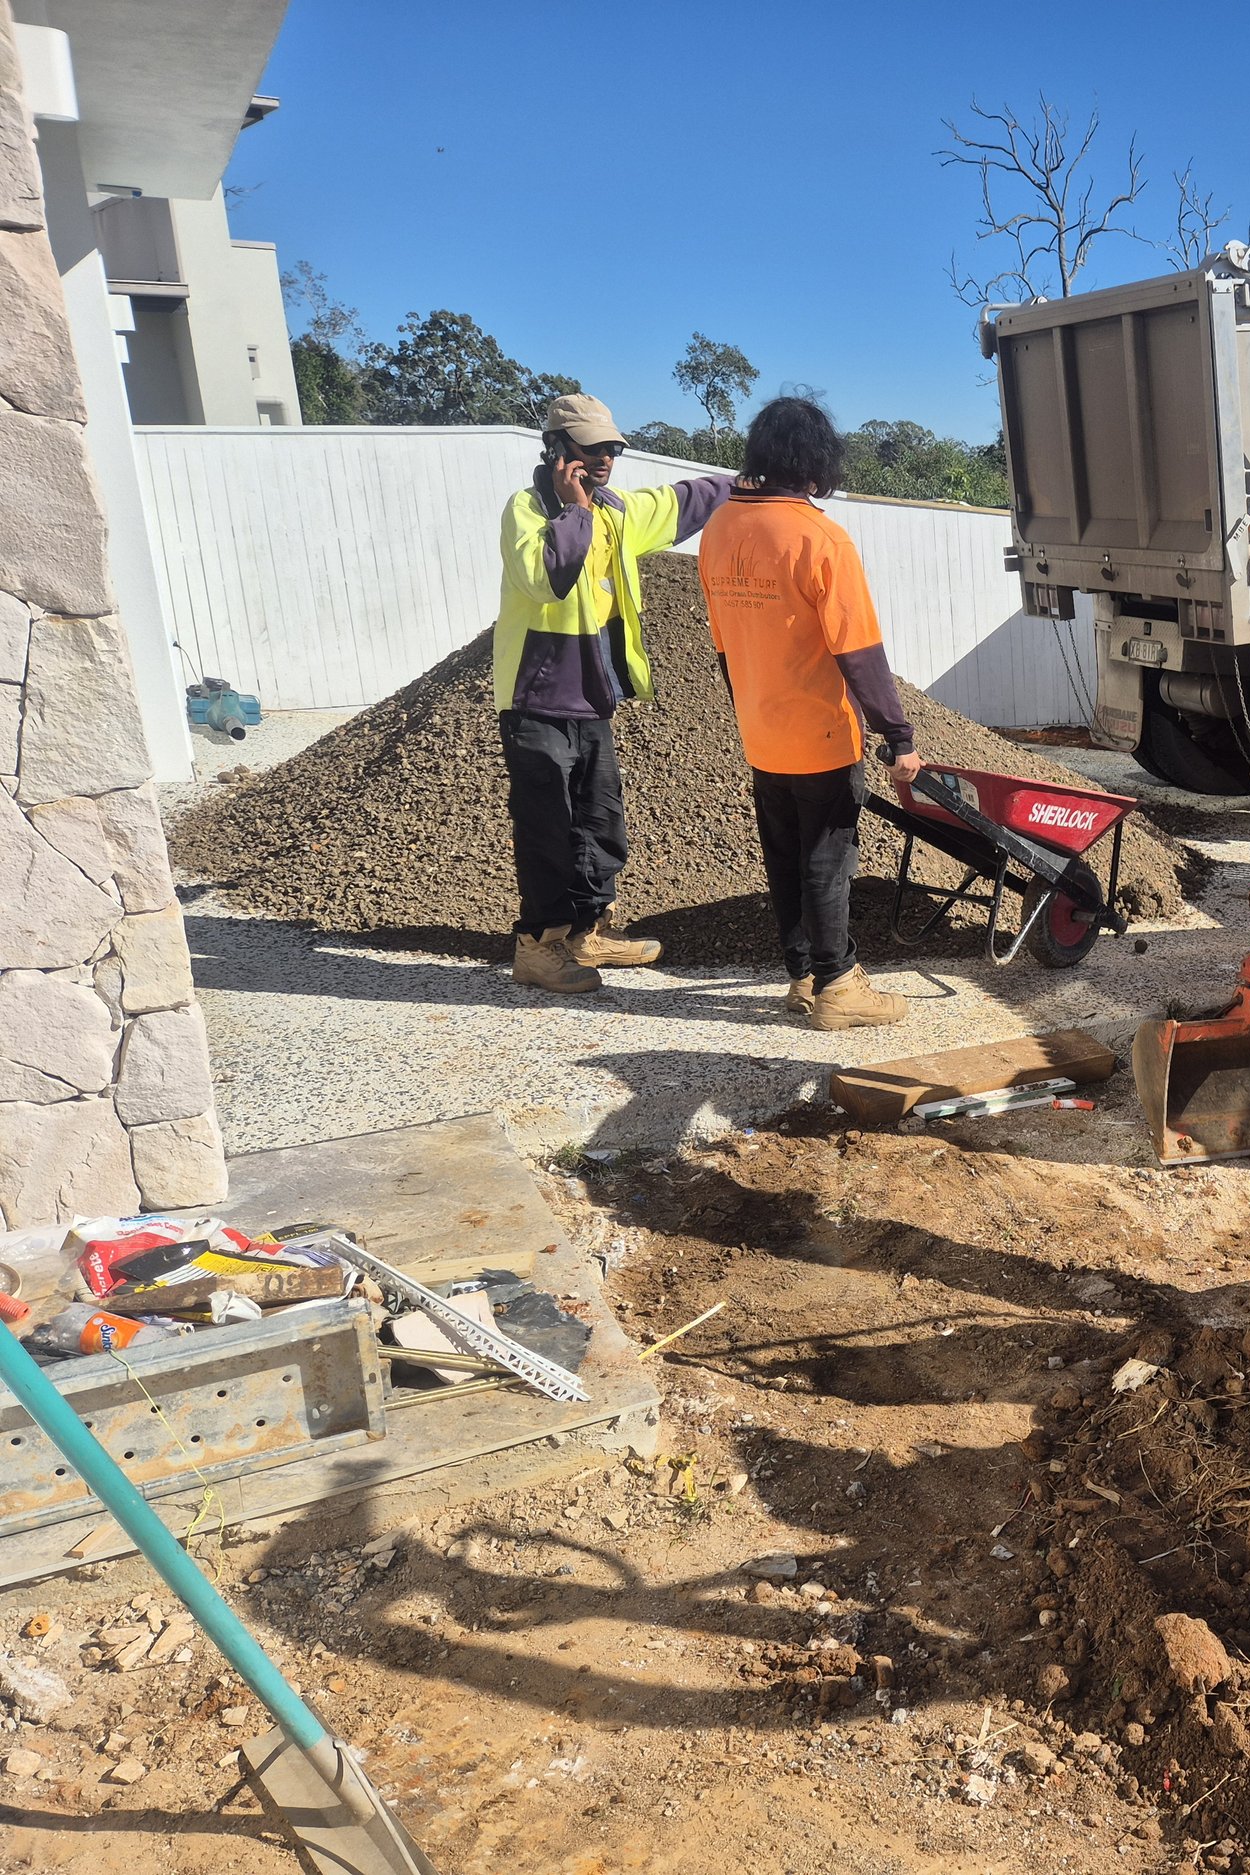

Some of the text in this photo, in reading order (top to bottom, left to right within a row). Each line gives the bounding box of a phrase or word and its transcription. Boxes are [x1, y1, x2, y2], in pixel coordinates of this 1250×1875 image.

[711, 576, 777, 589] SUPREME TURF
[1028, 802, 1099, 830] SHERLOCK
